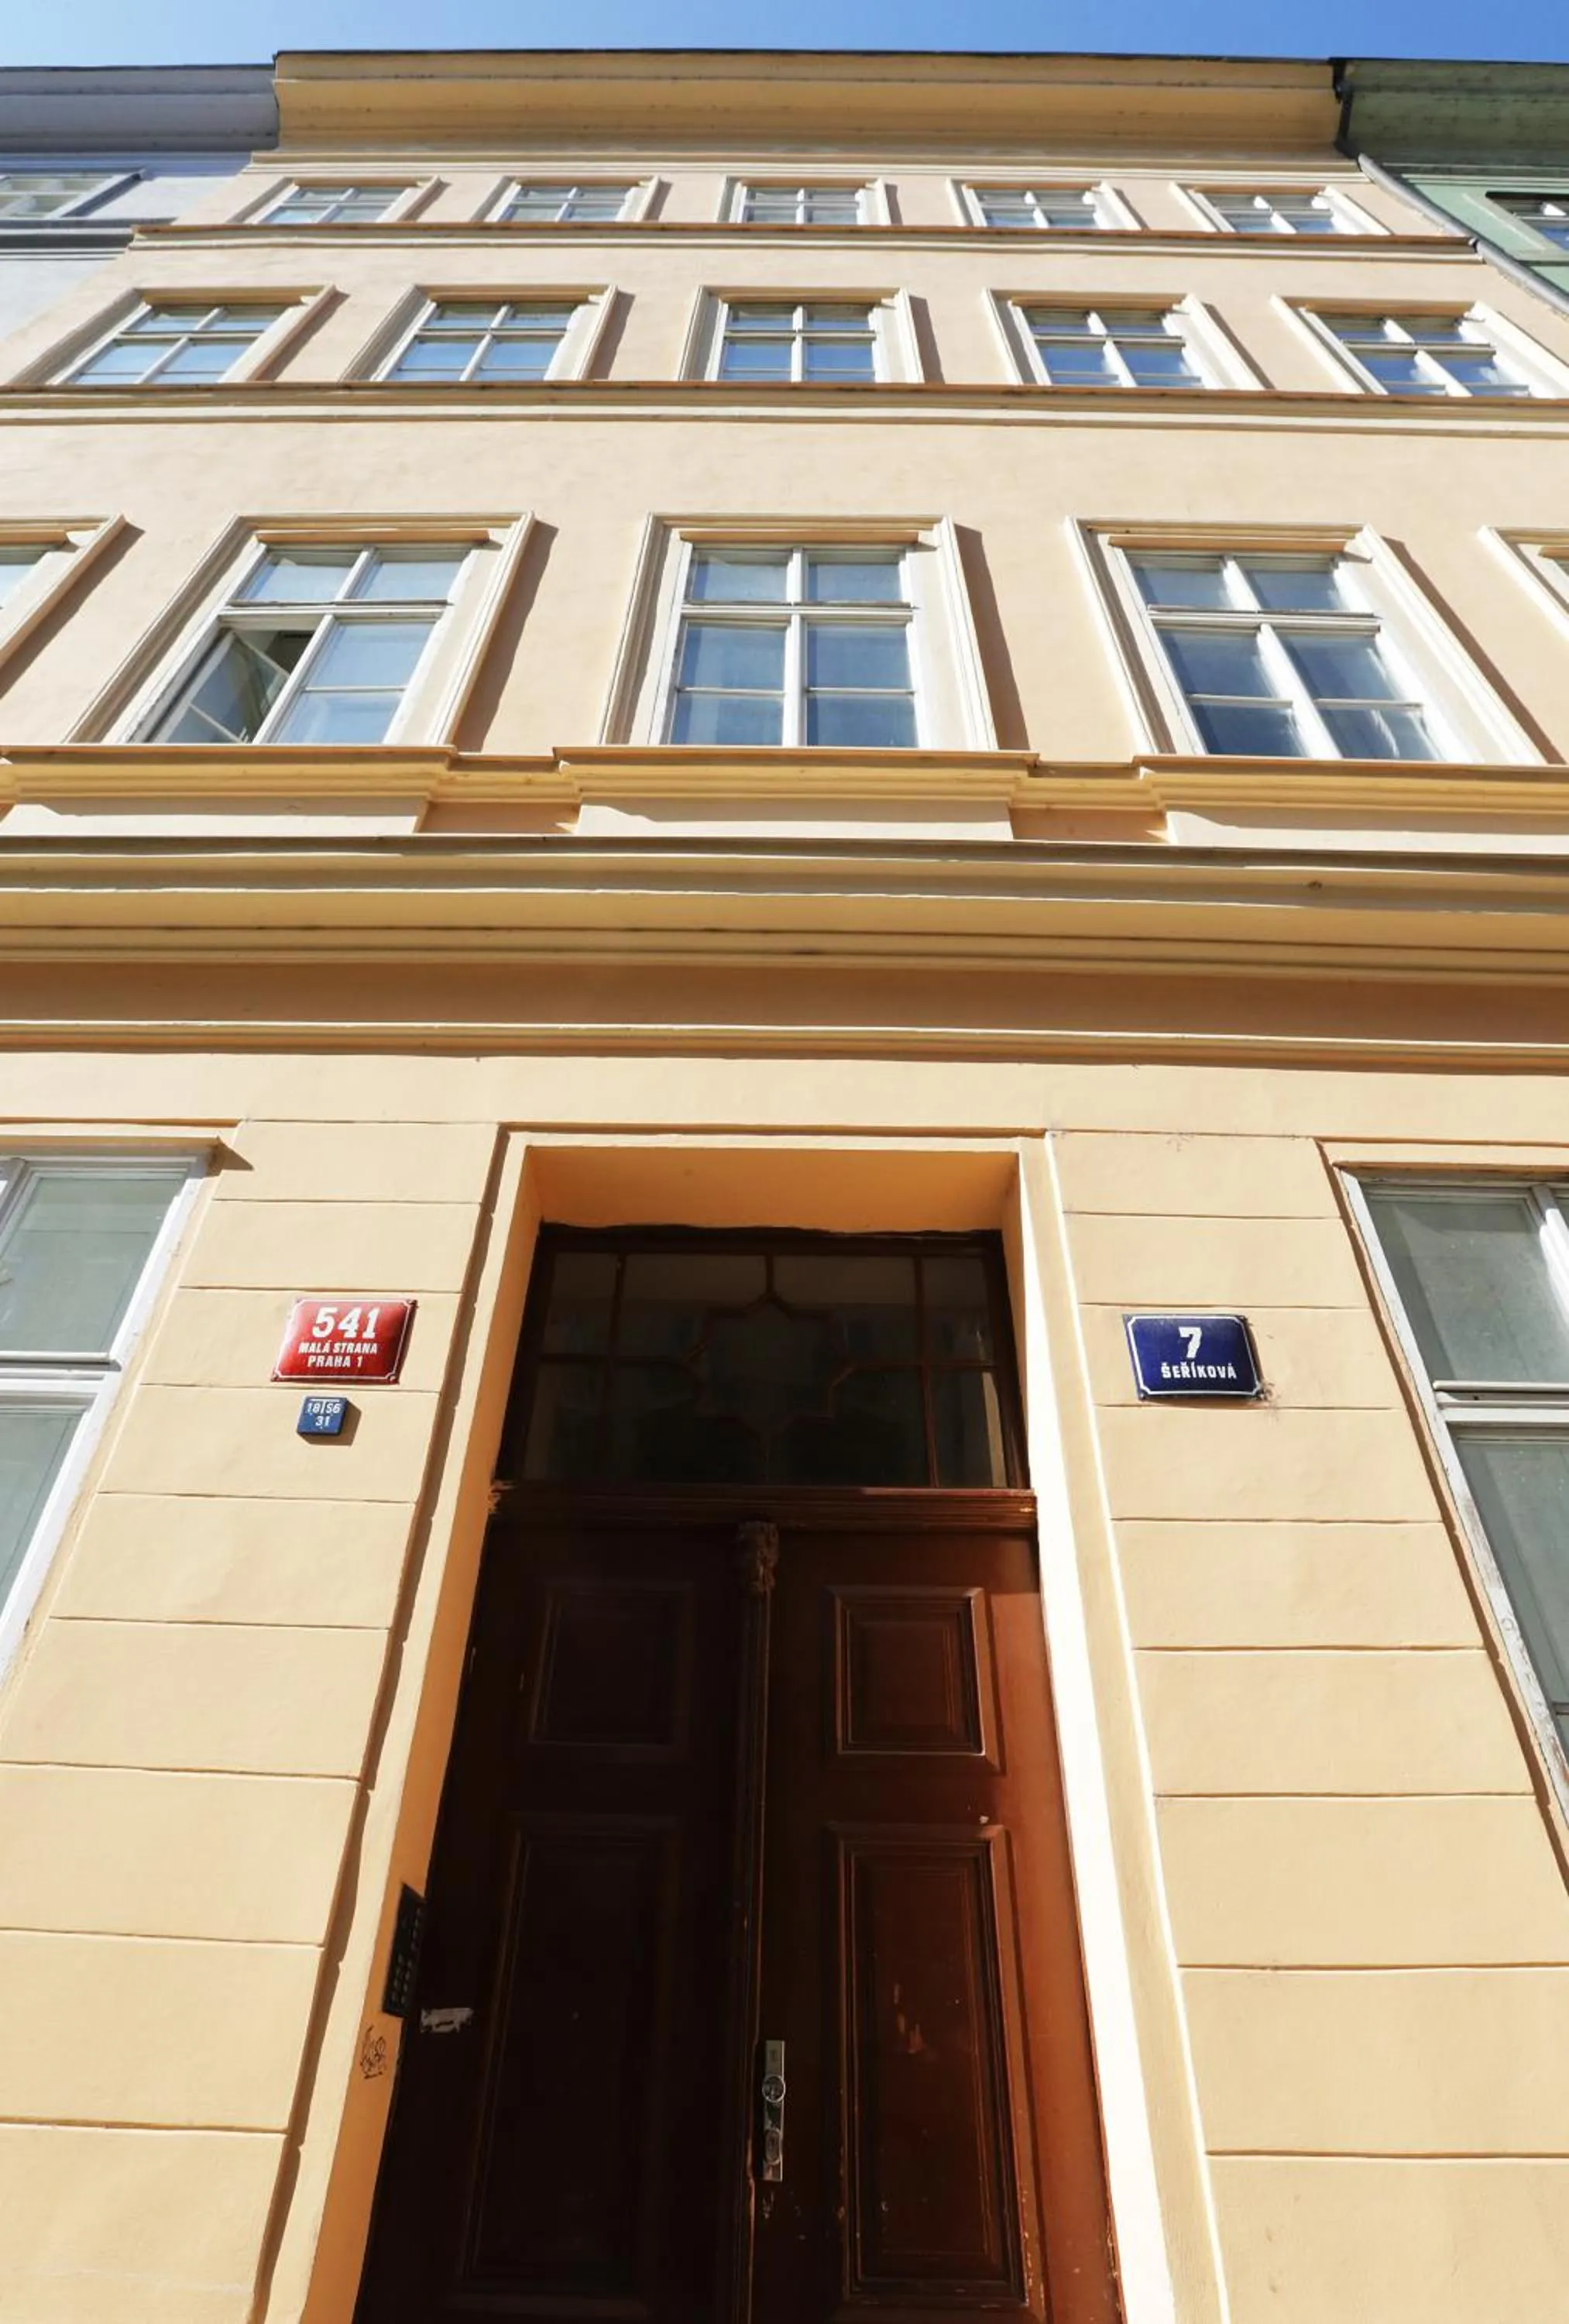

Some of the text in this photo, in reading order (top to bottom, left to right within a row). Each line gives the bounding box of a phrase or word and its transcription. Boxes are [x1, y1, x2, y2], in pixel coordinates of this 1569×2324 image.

[312, 1306, 380, 1339] 541
[298, 1340, 378, 1355] MALÁ STRANA
[1178, 1326, 1202, 1359] 7
[307, 1355, 364, 1368] PRAHA 1
[1162, 1361, 1237, 1379] ŠEŘÍKOVÁ
